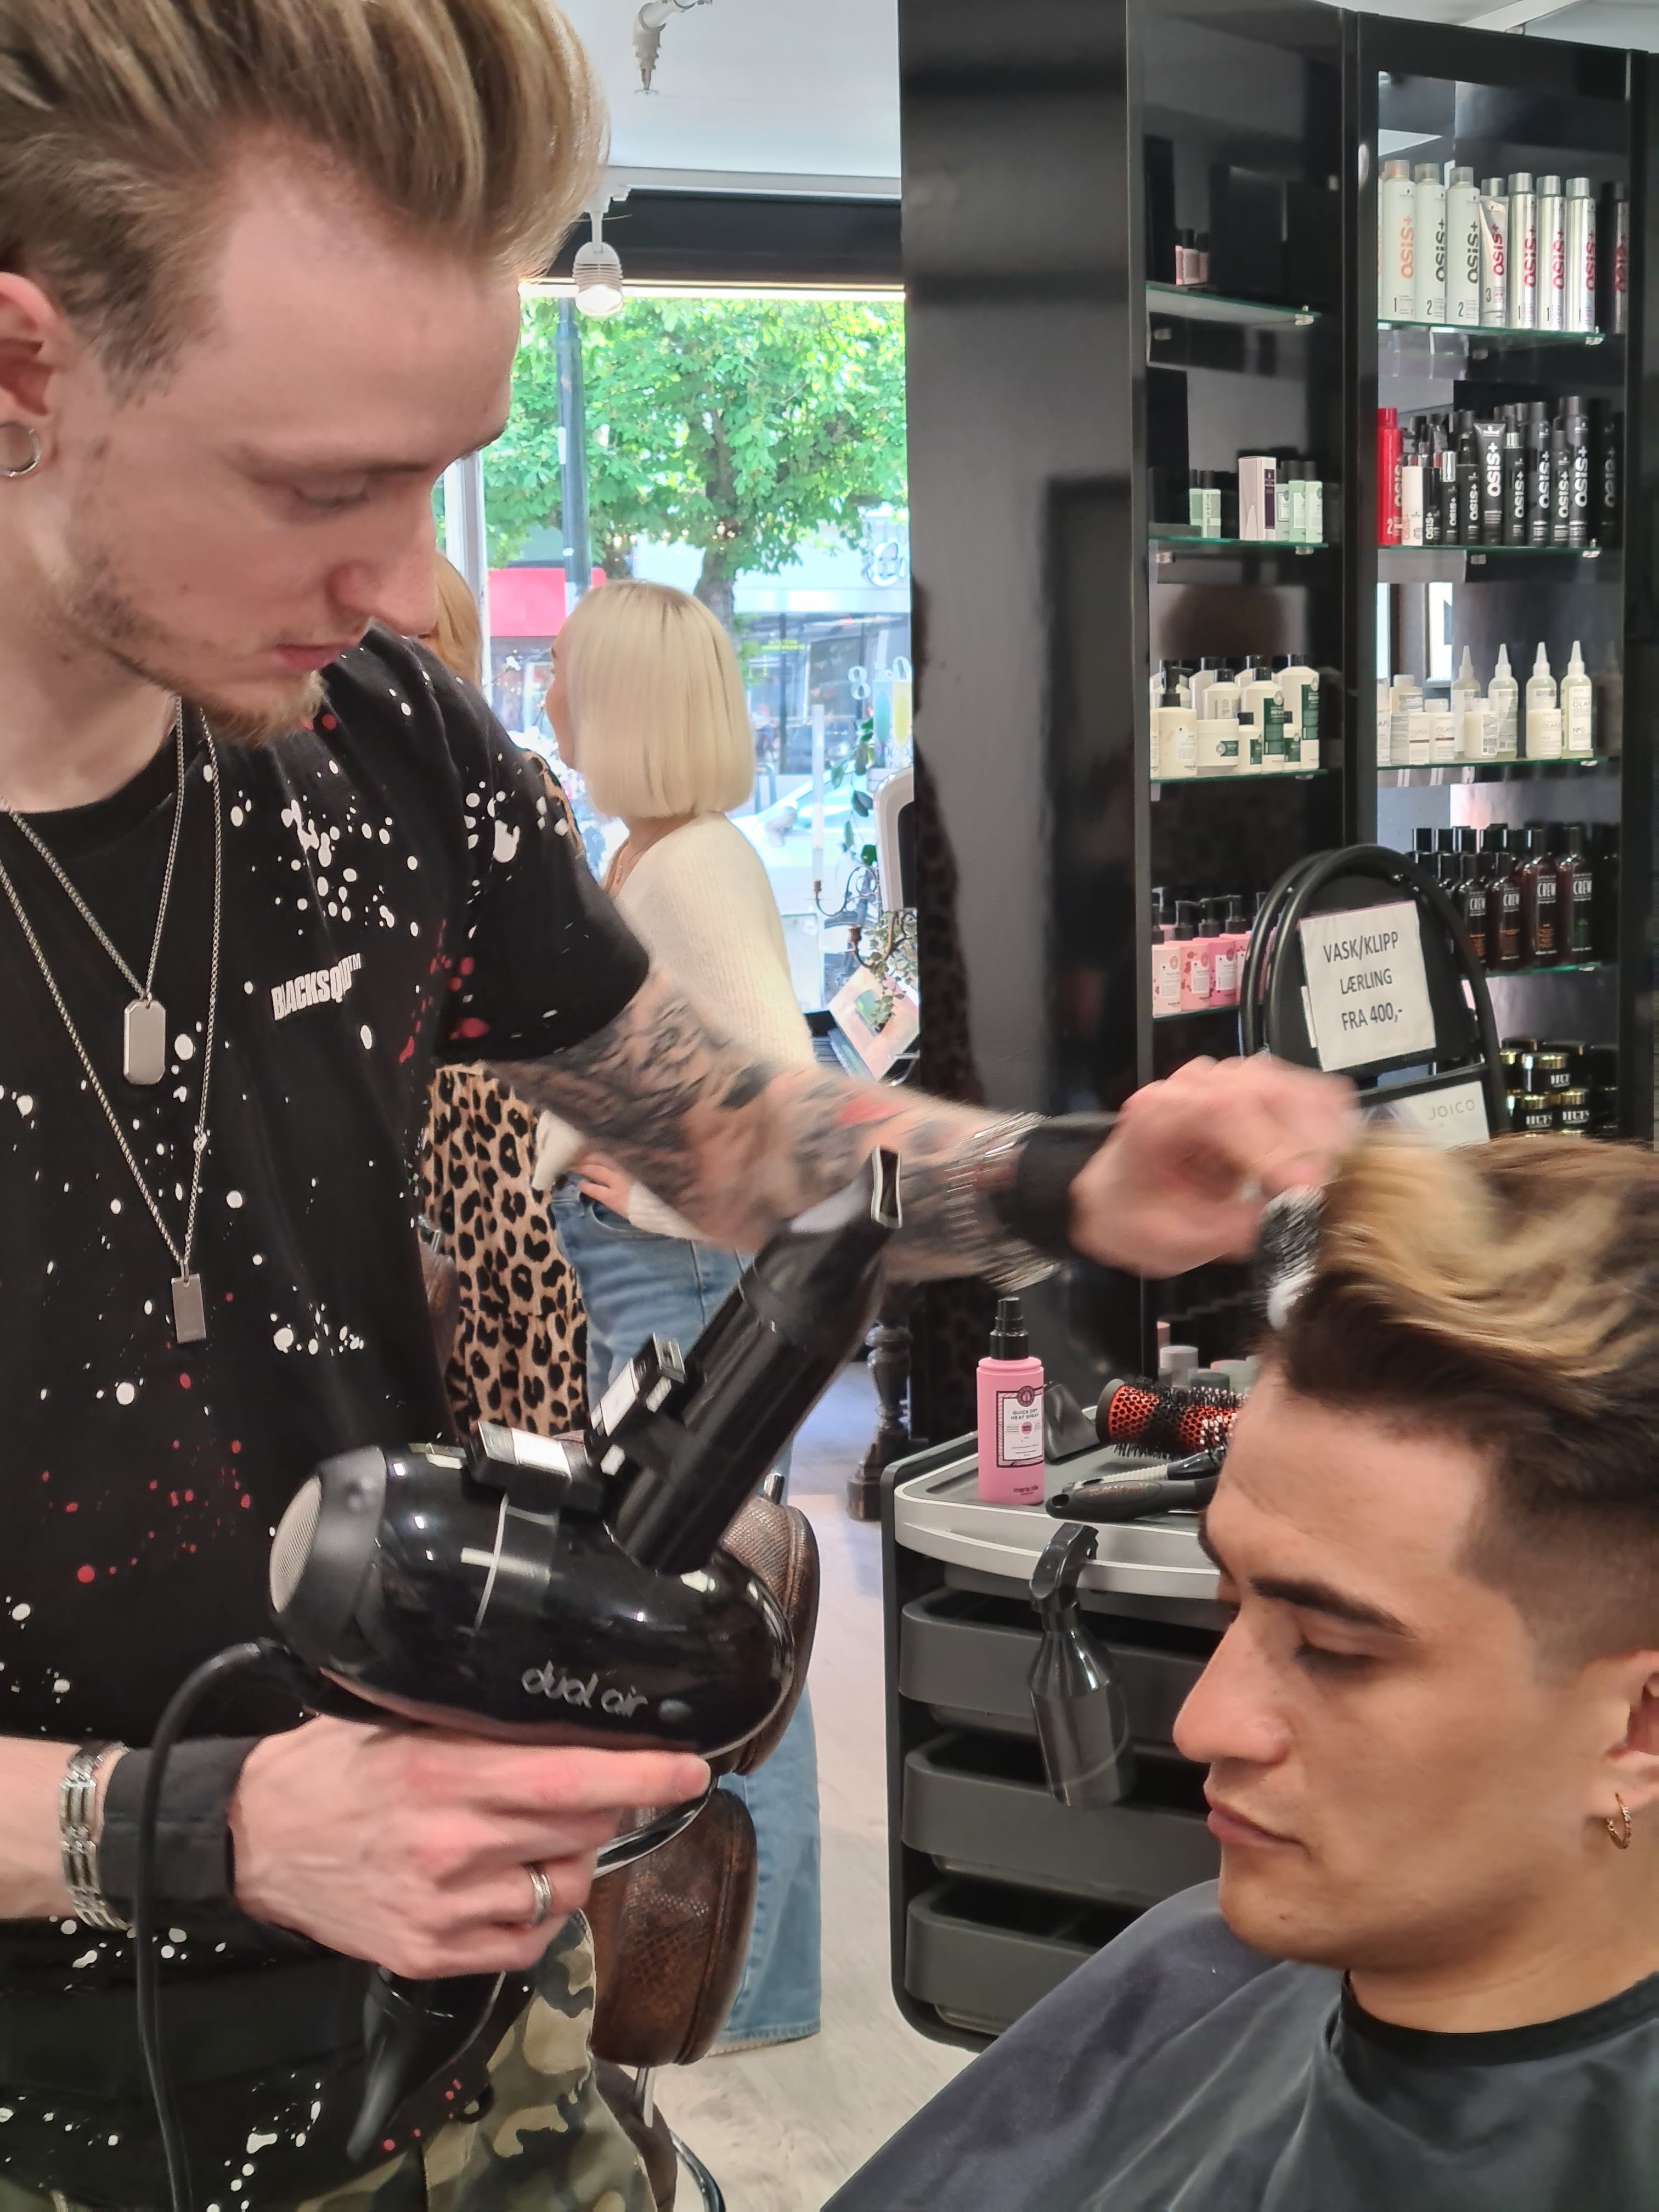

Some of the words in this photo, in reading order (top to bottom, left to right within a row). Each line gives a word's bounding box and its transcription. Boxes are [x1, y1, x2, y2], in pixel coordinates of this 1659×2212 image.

[1486, 287, 1492, 302] 3
[1393, 297, 1397, 313] 1
[1426, 300, 1432, 315] 2
[1458, 301, 1464, 317] 2
[1323, 931, 1398, 963] VASK/KLIPP
[1340, 968, 1393, 995] LÆRLING
[1341, 1009, 1368, 1031] FRA
[1370, 1002, 1403, 1024] 400,-
[1428, 1099, 1475, 1121] JOICO
